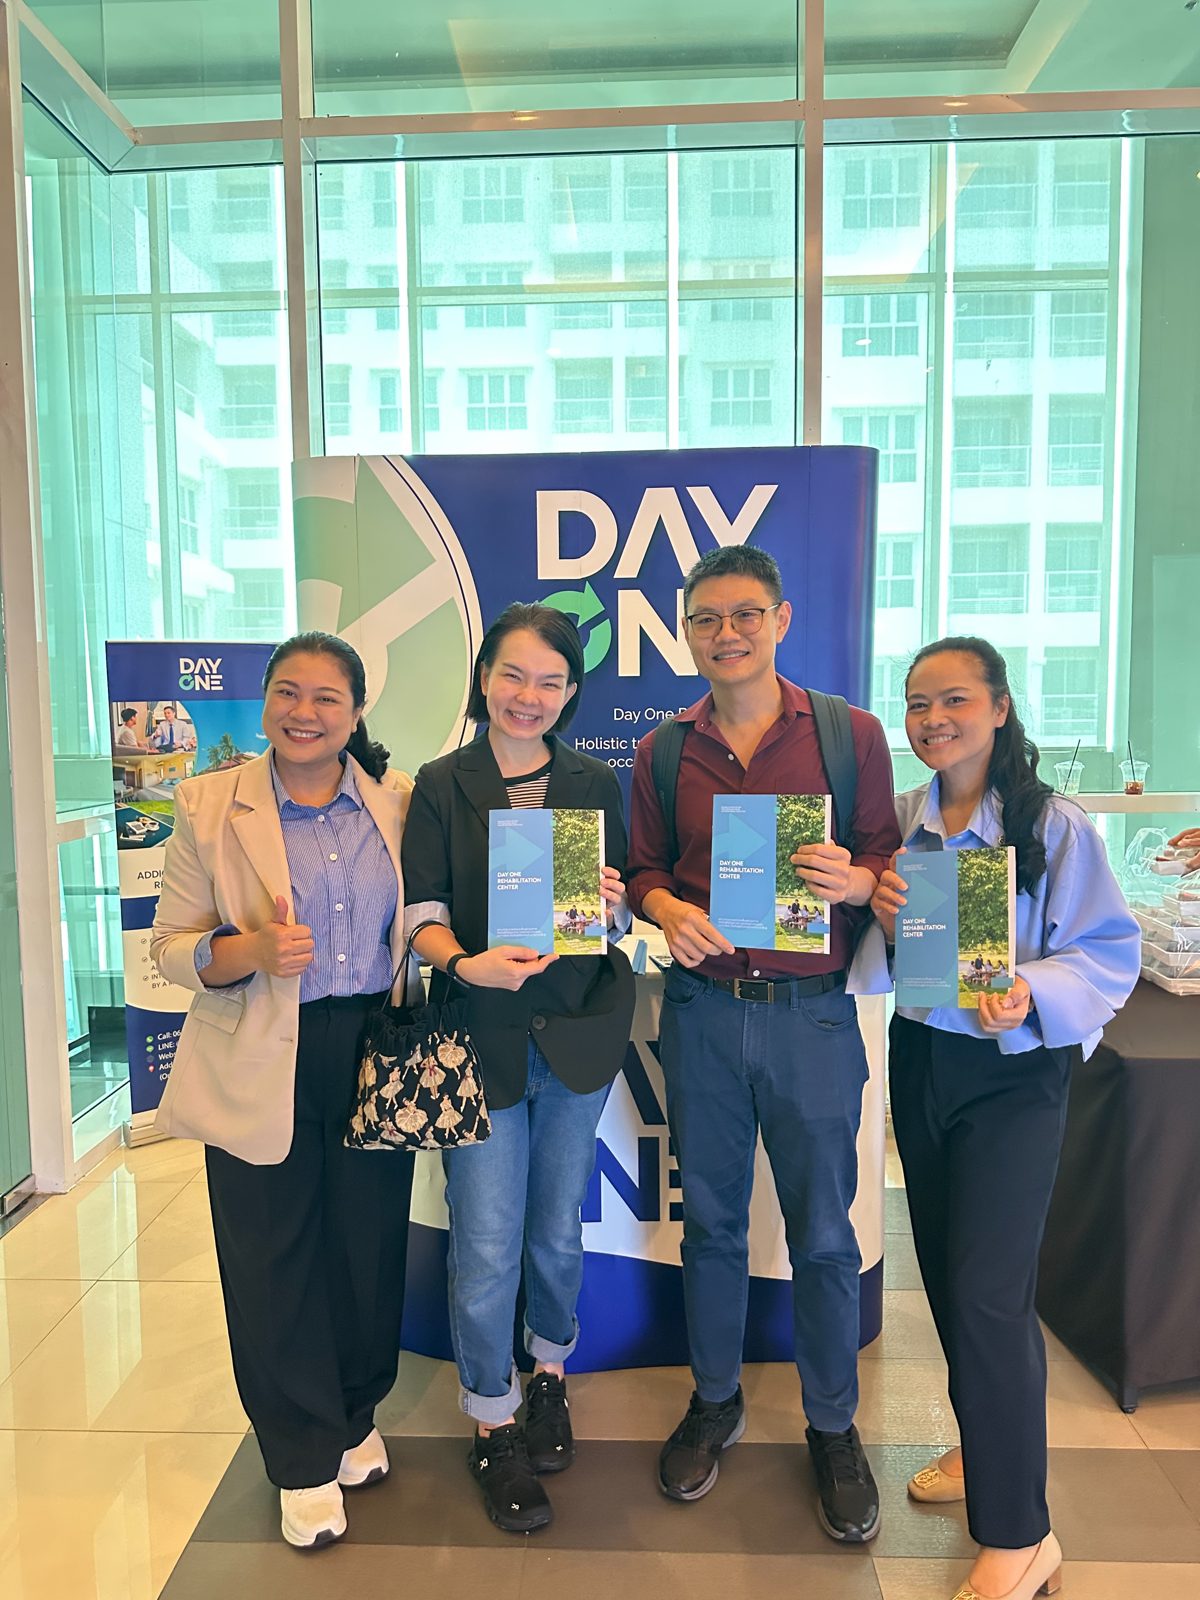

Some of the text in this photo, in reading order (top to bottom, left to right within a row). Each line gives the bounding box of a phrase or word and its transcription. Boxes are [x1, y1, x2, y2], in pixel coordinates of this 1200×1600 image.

[536, 485, 779, 580] DAY
[179, 657, 222, 674] DAY
[178, 674, 224, 690] ONE
[613, 708, 641, 723] Day
[644, 707, 674, 720] One
[575, 737, 628, 750] Holistic
[719, 866, 764, 874] REHABILITATION
